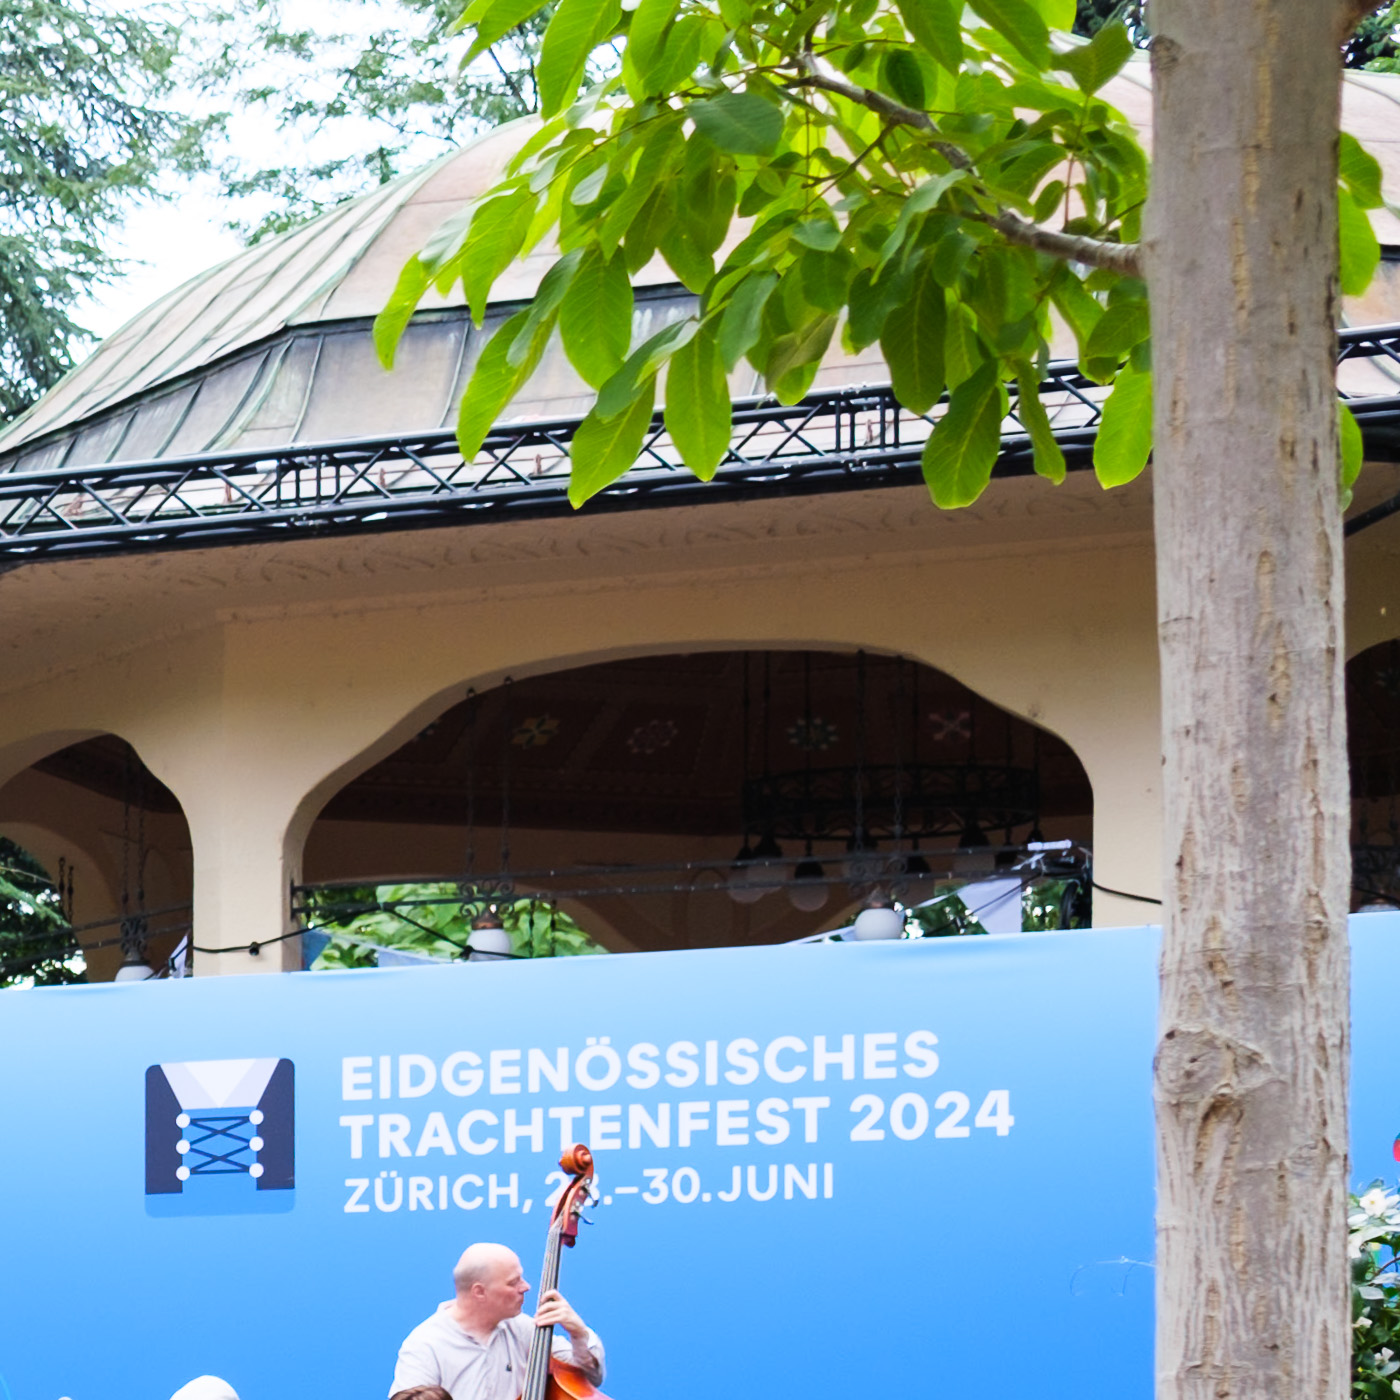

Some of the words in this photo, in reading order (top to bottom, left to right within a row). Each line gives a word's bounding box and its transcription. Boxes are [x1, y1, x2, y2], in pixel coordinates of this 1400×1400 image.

[342, 1030, 940, 1100] EIDGENÖSSISCHES
[339, 1096, 830, 1159] TRACHTENFEST
[850, 1090, 1015, 1142] 2024
[343, 1171, 532, 1214] ZÜRICH,
